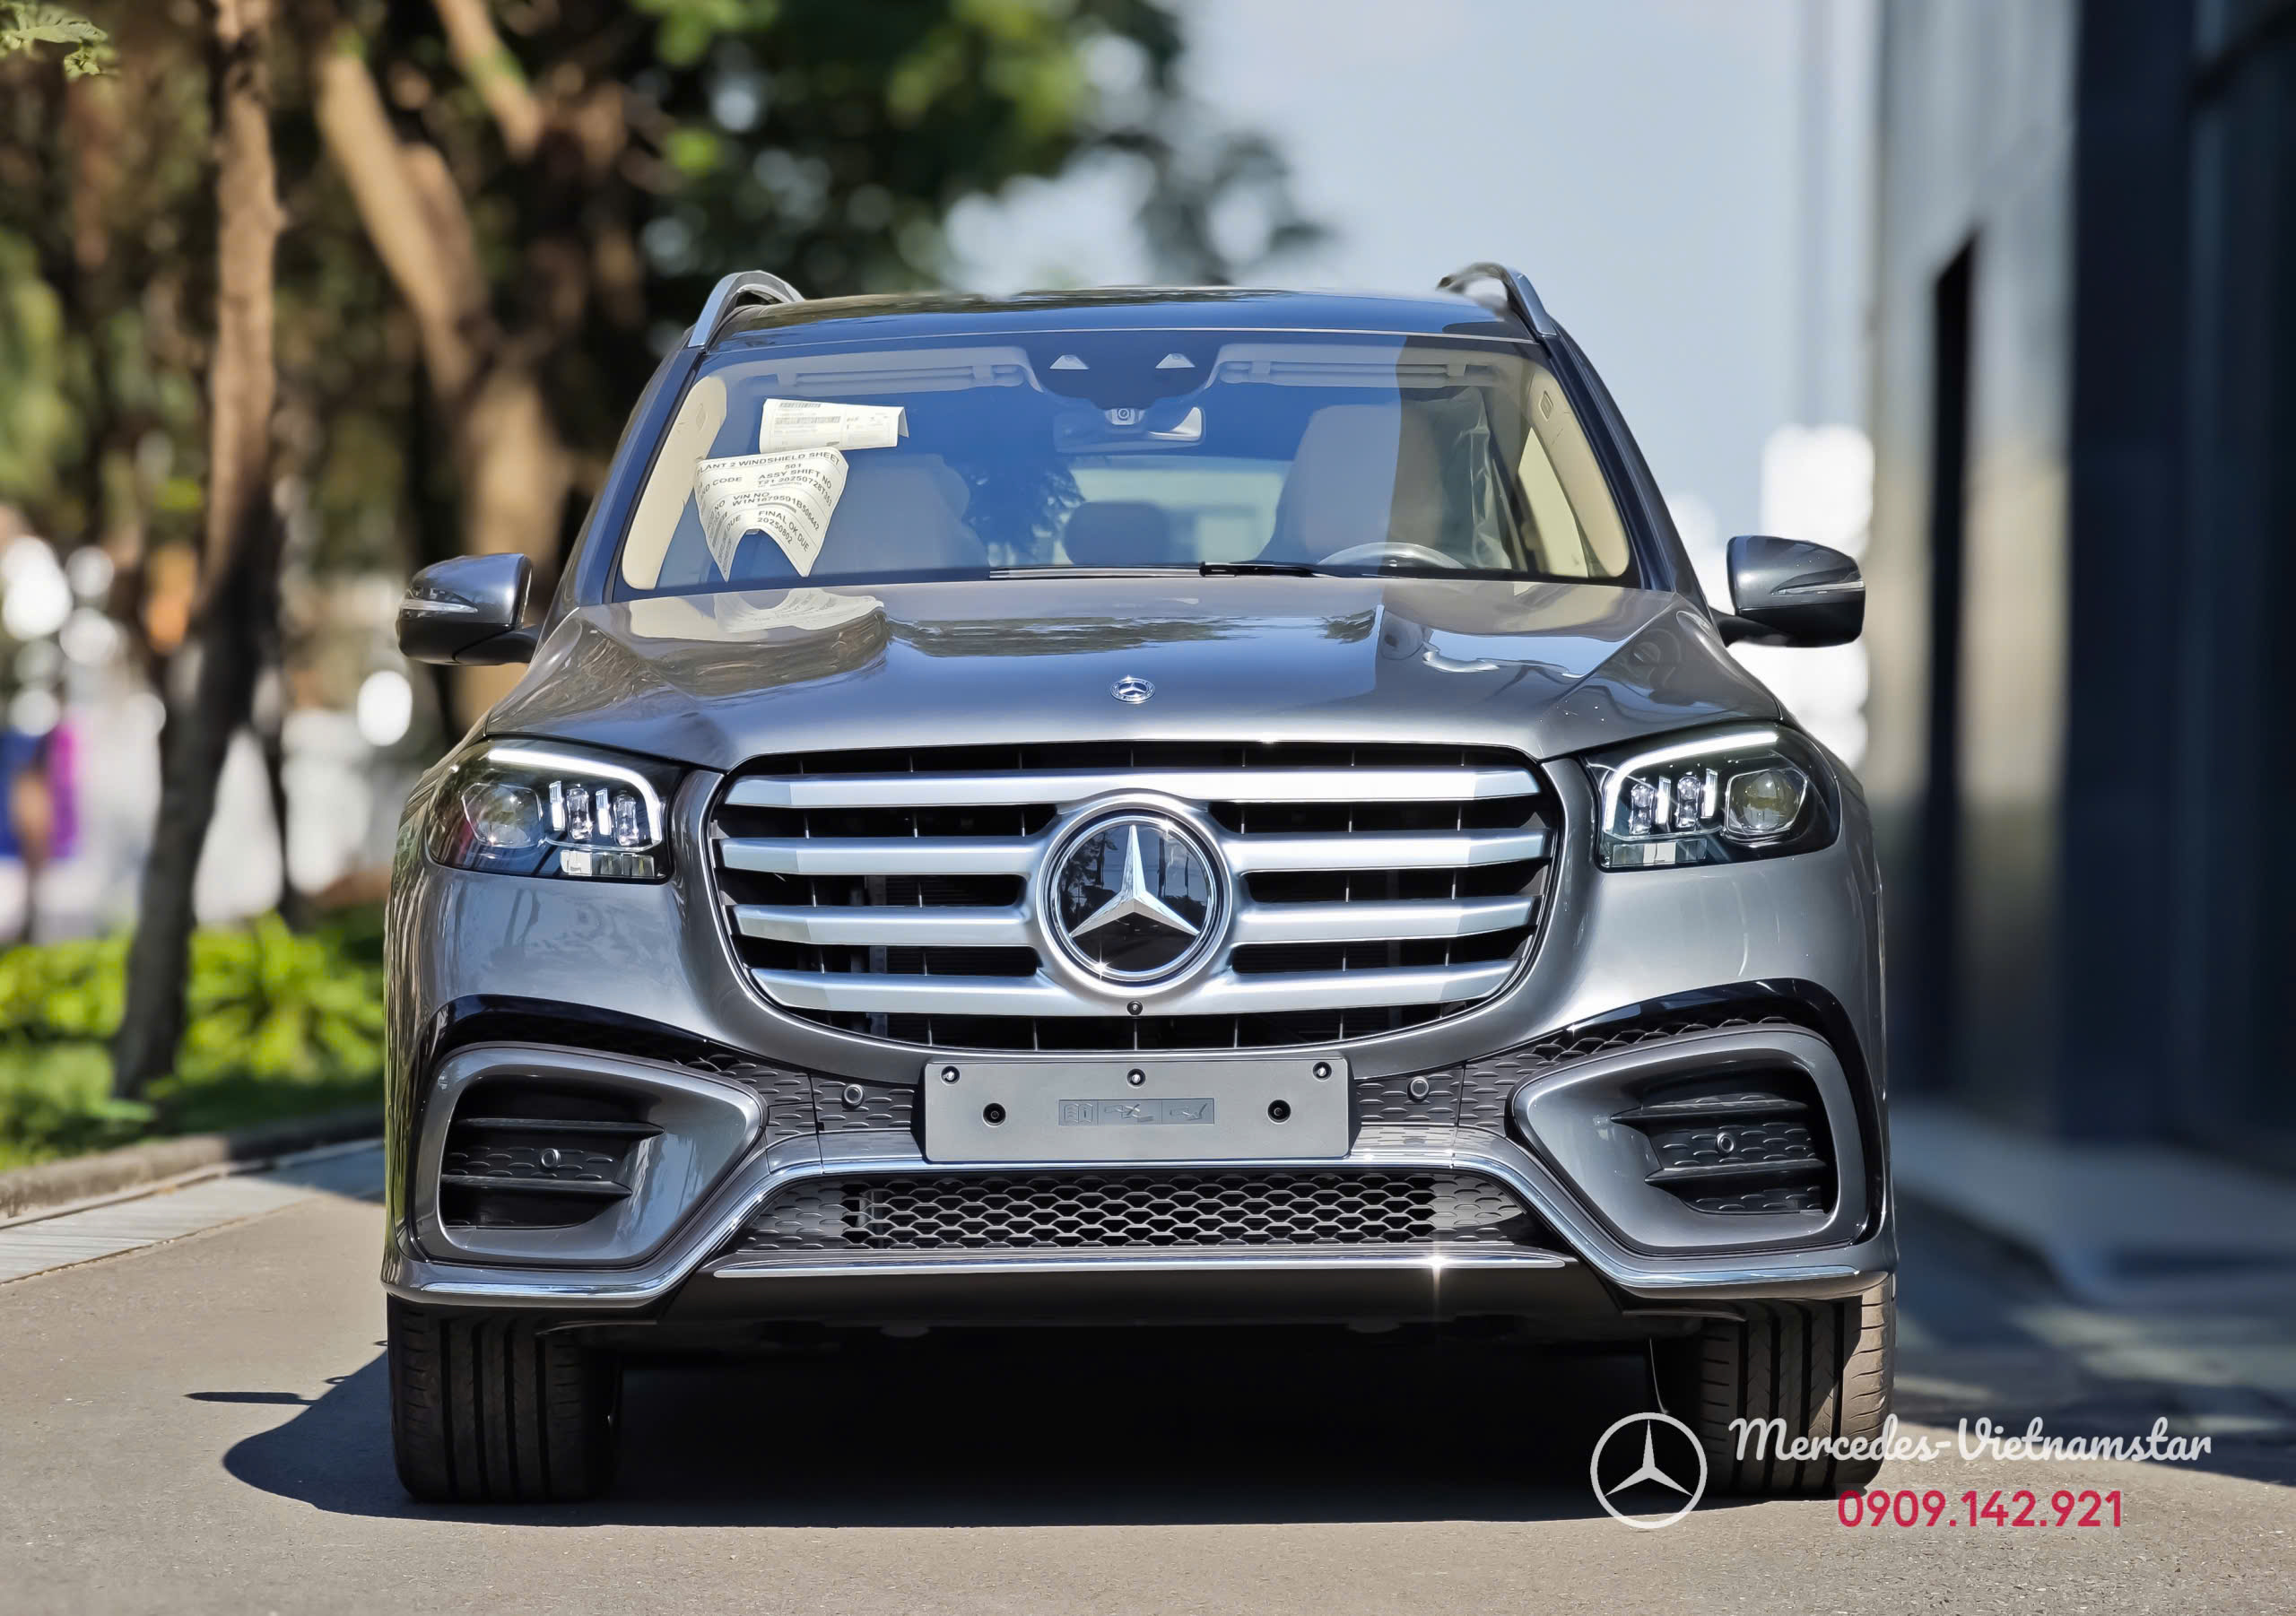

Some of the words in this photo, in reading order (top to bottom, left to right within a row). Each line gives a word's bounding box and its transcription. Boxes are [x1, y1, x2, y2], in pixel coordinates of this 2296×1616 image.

[739, 454, 805, 466] WINDSHIELD
[809, 452, 839, 465] SHEET
[712, 476, 743, 486] CODE
[759, 471, 787, 480] ASSY
[790, 468, 821, 477] SHIFT
[822, 474, 832, 489] NO
[734, 492, 751, 500] VIN
[715, 500, 726, 511] NO
[726, 515, 742, 531] DUE
[757, 517, 793, 544] 20250802
[759, 510, 787, 524] FINAL
[789, 522, 798, 535] OK
[797, 534, 810, 552] DUE
